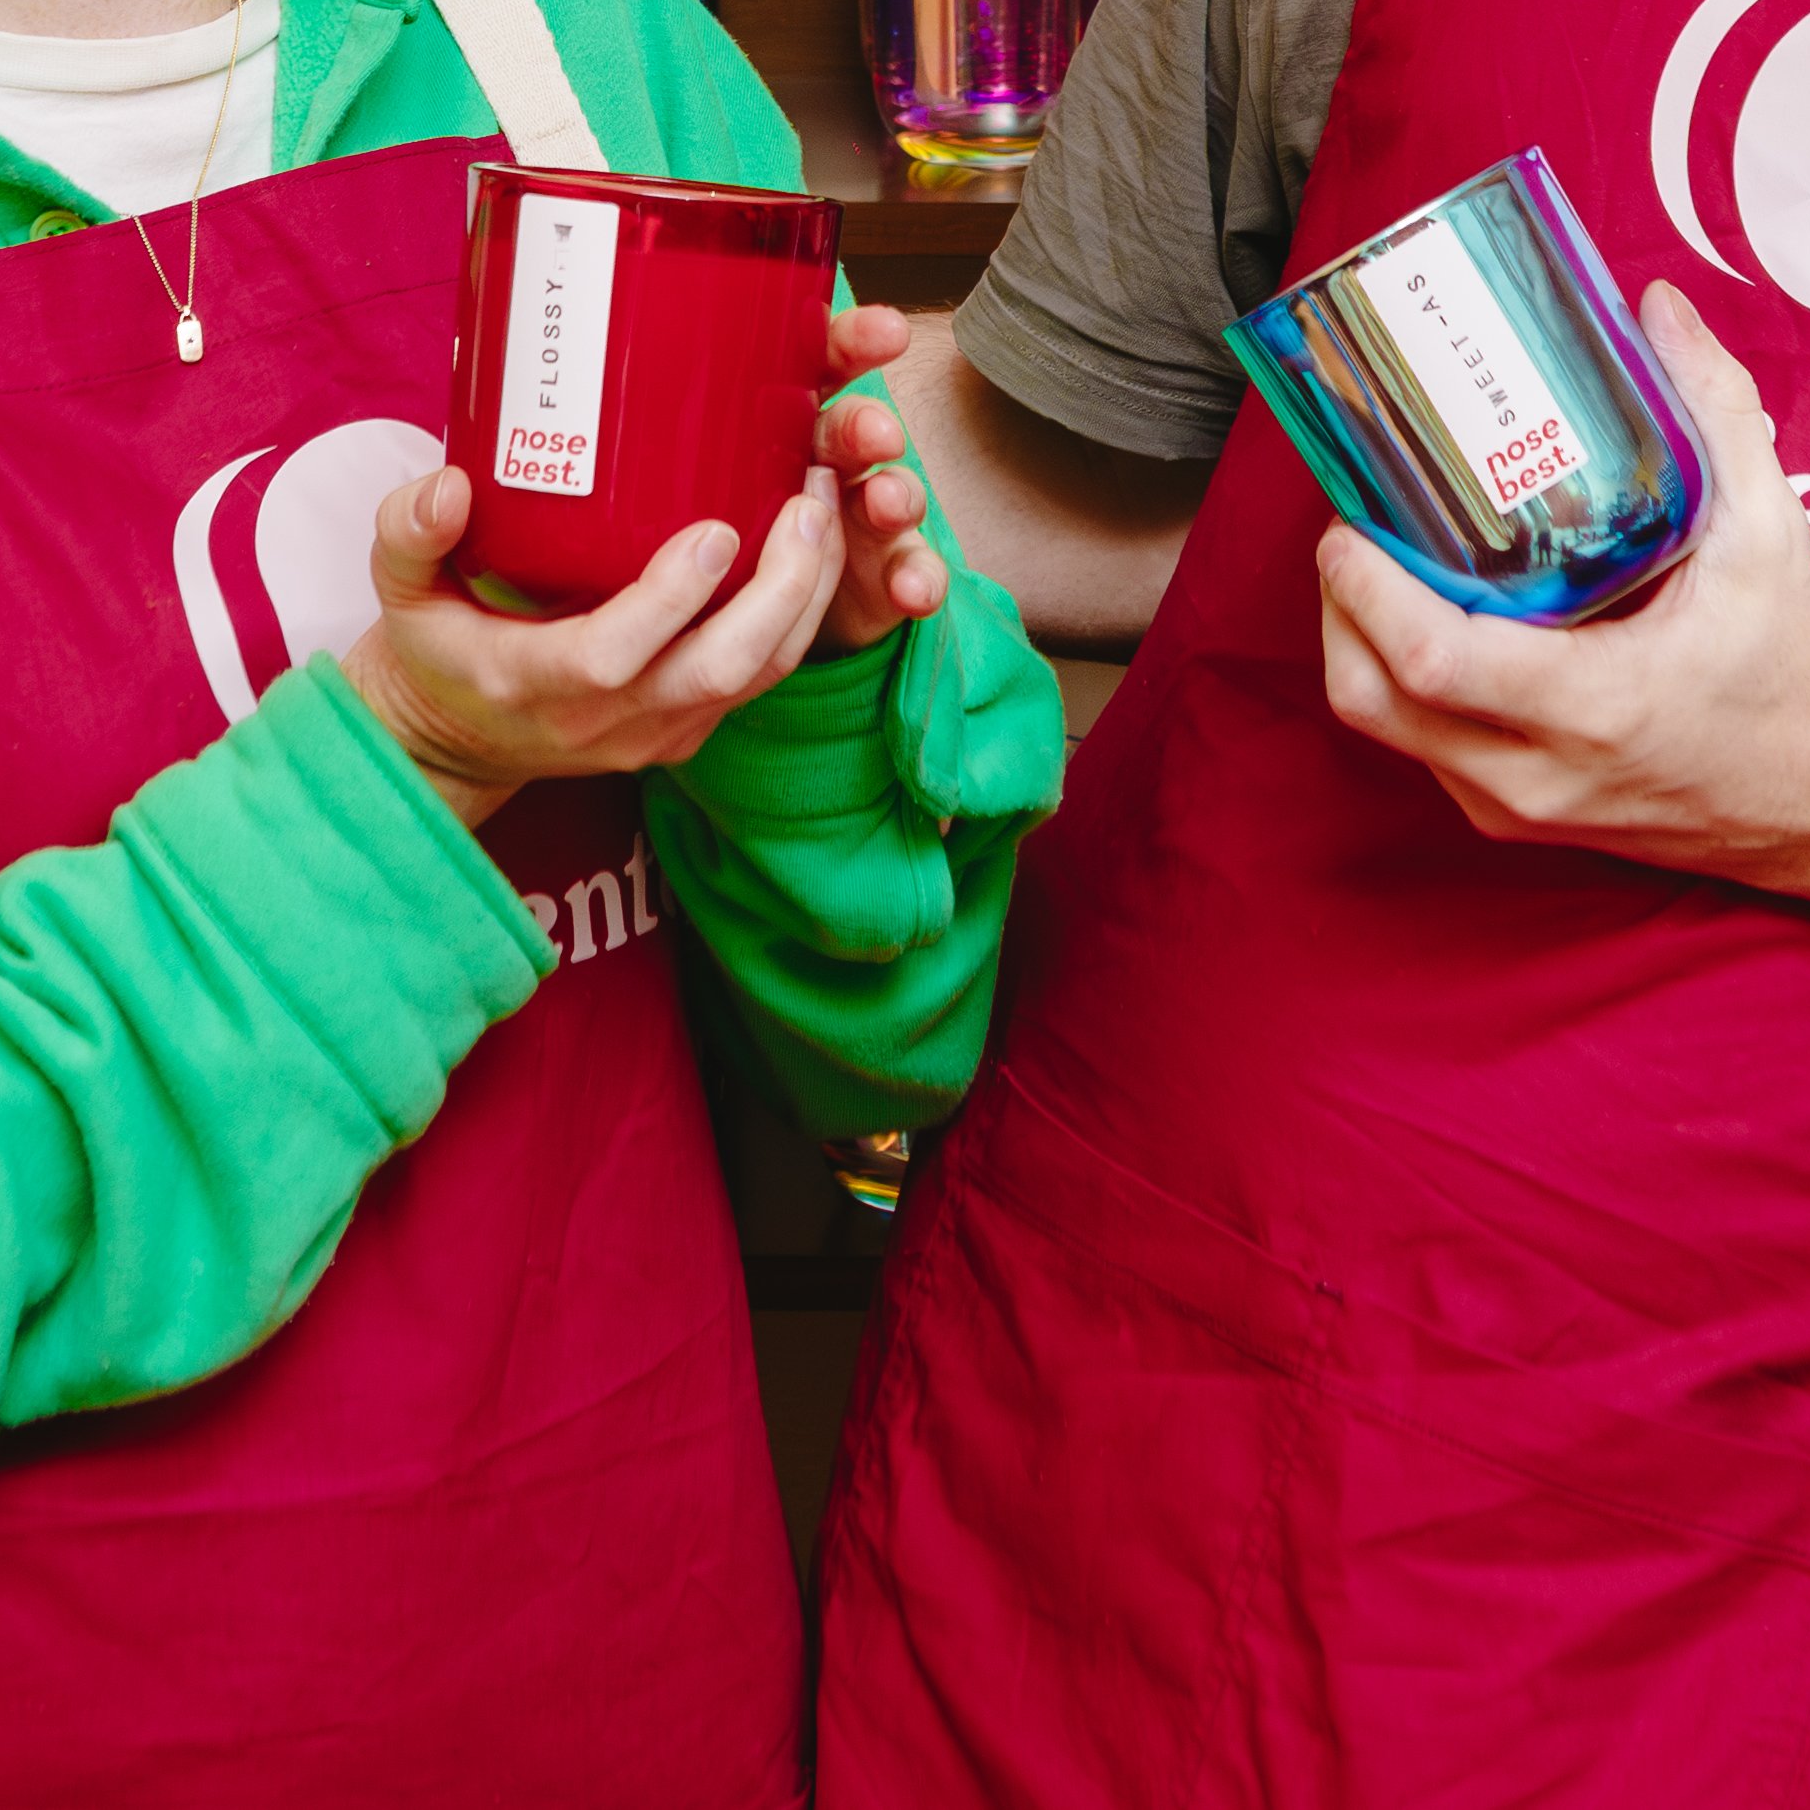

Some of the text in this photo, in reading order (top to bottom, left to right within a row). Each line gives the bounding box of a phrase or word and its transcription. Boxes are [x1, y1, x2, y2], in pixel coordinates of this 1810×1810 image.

[539, 278, 565, 410] FLOSSY
[1406, 273, 1516, 428] SWEET-AS
[502, 448, 581, 488] best.
[508, 426, 588, 456] nose
[1486, 418, 1561, 475] nose
[1494, 444, 1577, 504] best.
[522, 832, 660, 964] ent
